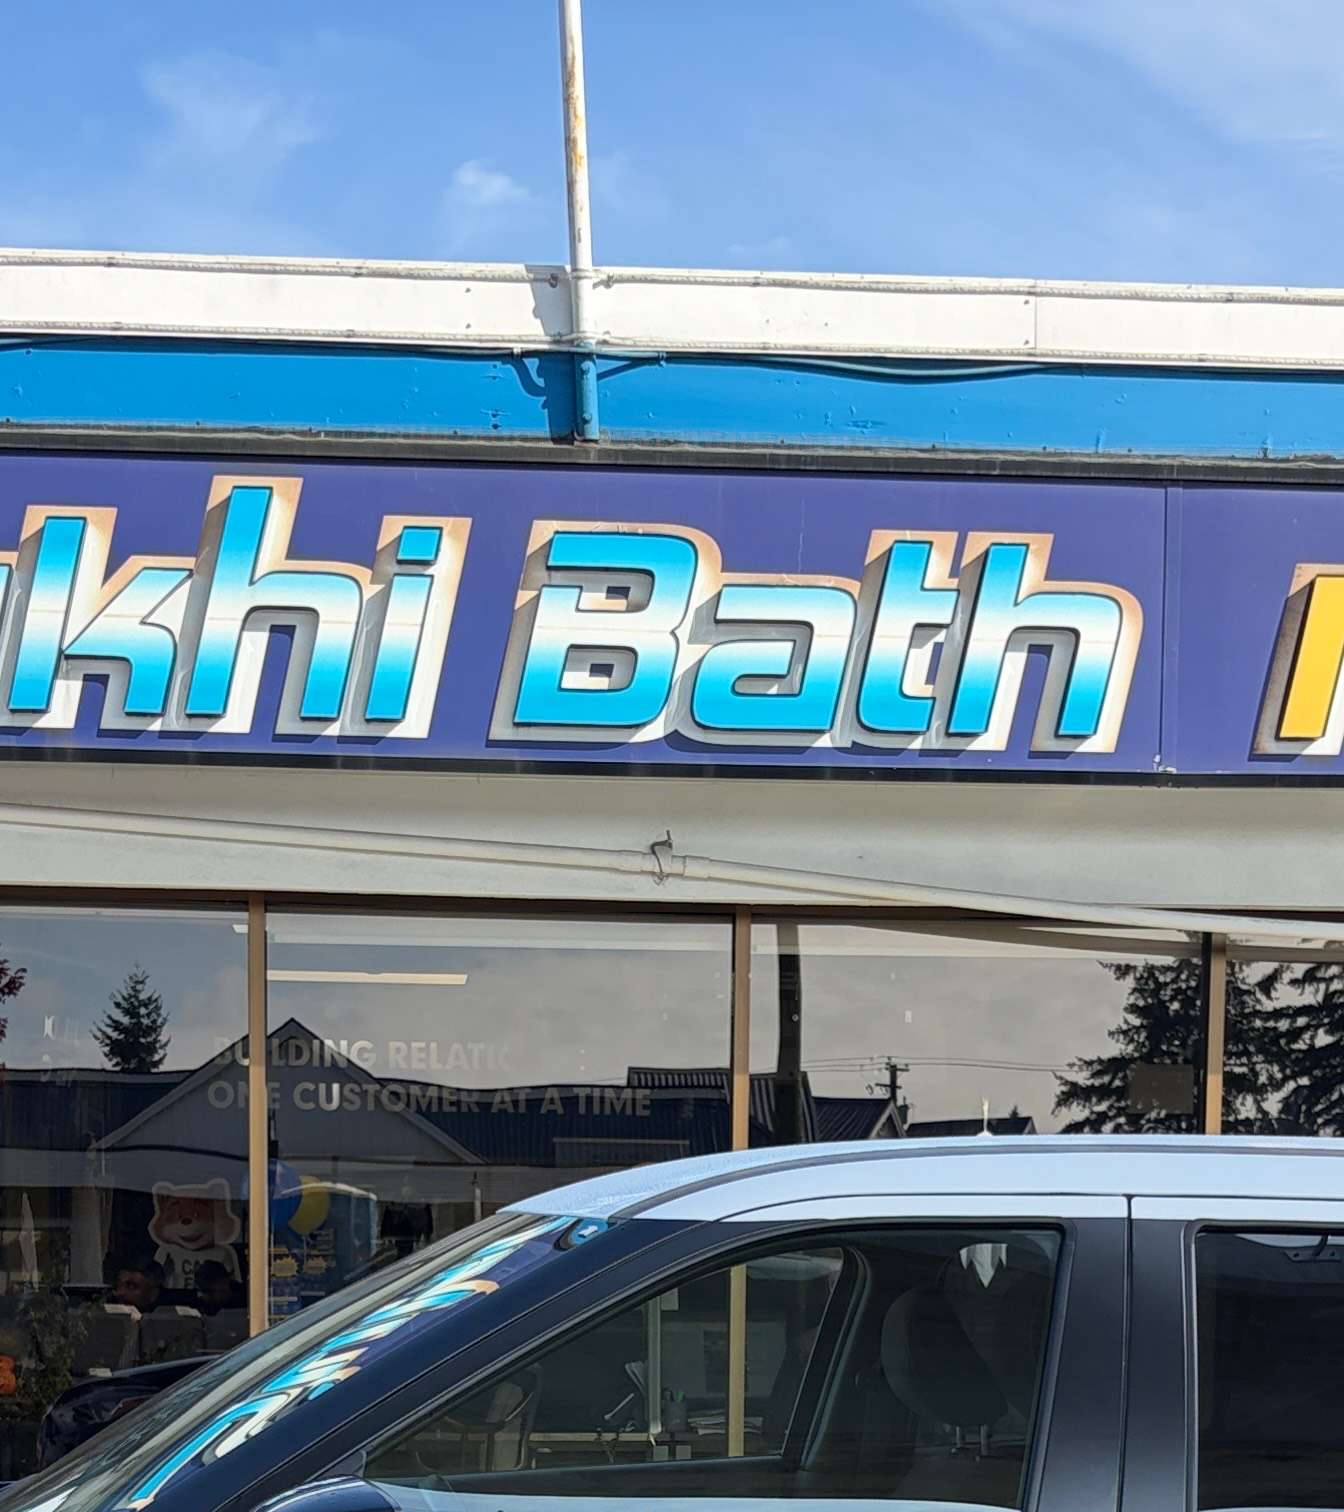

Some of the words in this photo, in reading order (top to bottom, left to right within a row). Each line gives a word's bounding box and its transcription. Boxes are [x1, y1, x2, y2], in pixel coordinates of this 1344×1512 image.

[488, 519, 1144, 754] Bath
[212, 1036, 376, 1068] BULDING
[293, 1082, 480, 1113] CUSTOMER
[491, 1088, 534, 1113] AT
[540, 1089, 565, 1115] A
[573, 1088, 651, 1116] TIME
